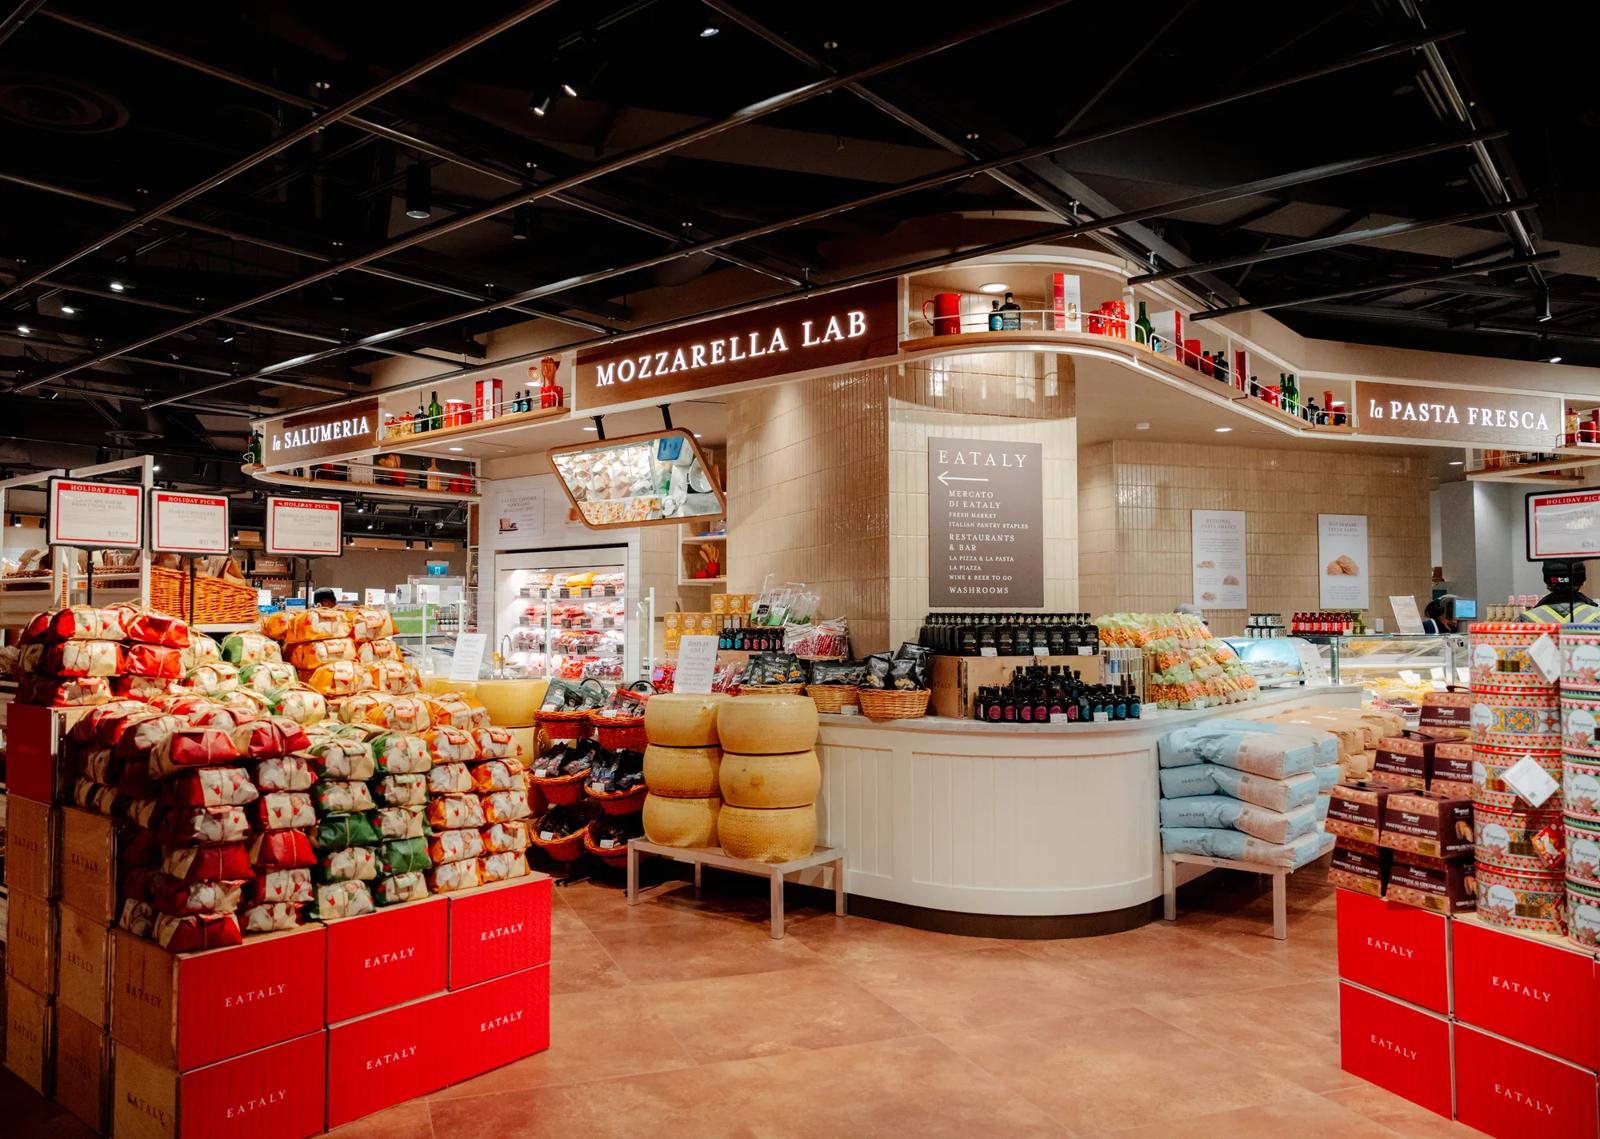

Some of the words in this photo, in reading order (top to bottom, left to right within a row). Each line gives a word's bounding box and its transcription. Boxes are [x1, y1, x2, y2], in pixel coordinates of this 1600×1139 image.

[596, 326, 788, 386] MOZZARELLA
[801, 310, 867, 348] LAB
[1370, 400, 1383, 419] la
[1390, 400, 1460, 424] PASTA
[1467, 406, 1550, 430] FRESCA
[272, 434, 281, 450] la
[284, 416, 370, 449] SALUMERIA
[938, 450, 1028, 468] EATALY
[70, 484, 106, 494] HOLIDAY
[949, 490, 994, 498] MERCATO
[963, 501, 1001, 509] EATALY
[949, 533, 1016, 542] RESTAURANTS
[480, 922, 524, 942] EATALY
[364, 947, 415, 969] EATALY
[1367, 937, 1414, 958] EATALY
[126, 984, 163, 1008] EATALY
[225, 983, 286, 1008] EATALY
[1492, 976, 1552, 1002] EATALY
[480, 1010, 524, 1032] EATALY
[366, 1045, 418, 1070] EATALY
[1370, 1034, 1418, 1060] EATALY
[127, 1092, 165, 1122] EATALY
[226, 1089, 286, 1119] EATALY
[1494, 1084, 1554, 1115] EATALY
